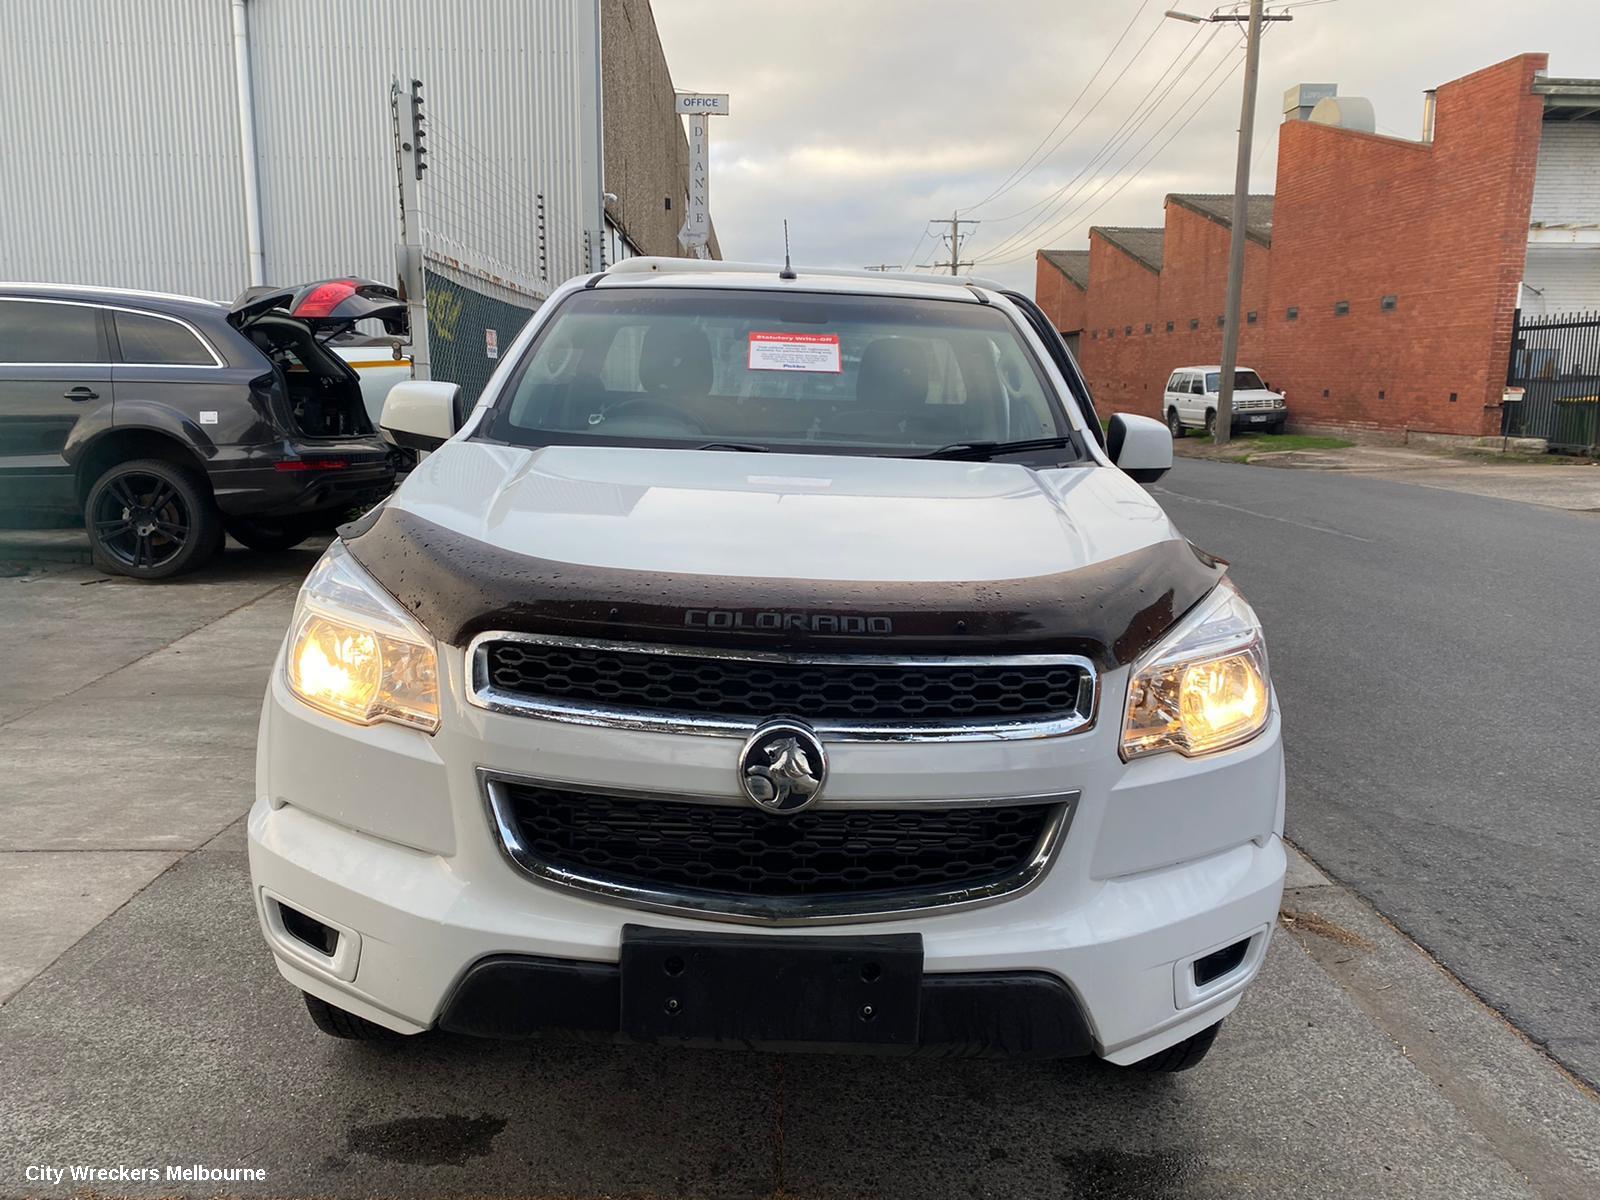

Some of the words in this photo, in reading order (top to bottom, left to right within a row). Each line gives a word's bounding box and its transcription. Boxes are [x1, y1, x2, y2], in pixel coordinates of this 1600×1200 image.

[683, 98, 719, 107] OFFICE
[694, 127, 705, 223] DIANNE
[684, 609, 893, 633] COLORADO
